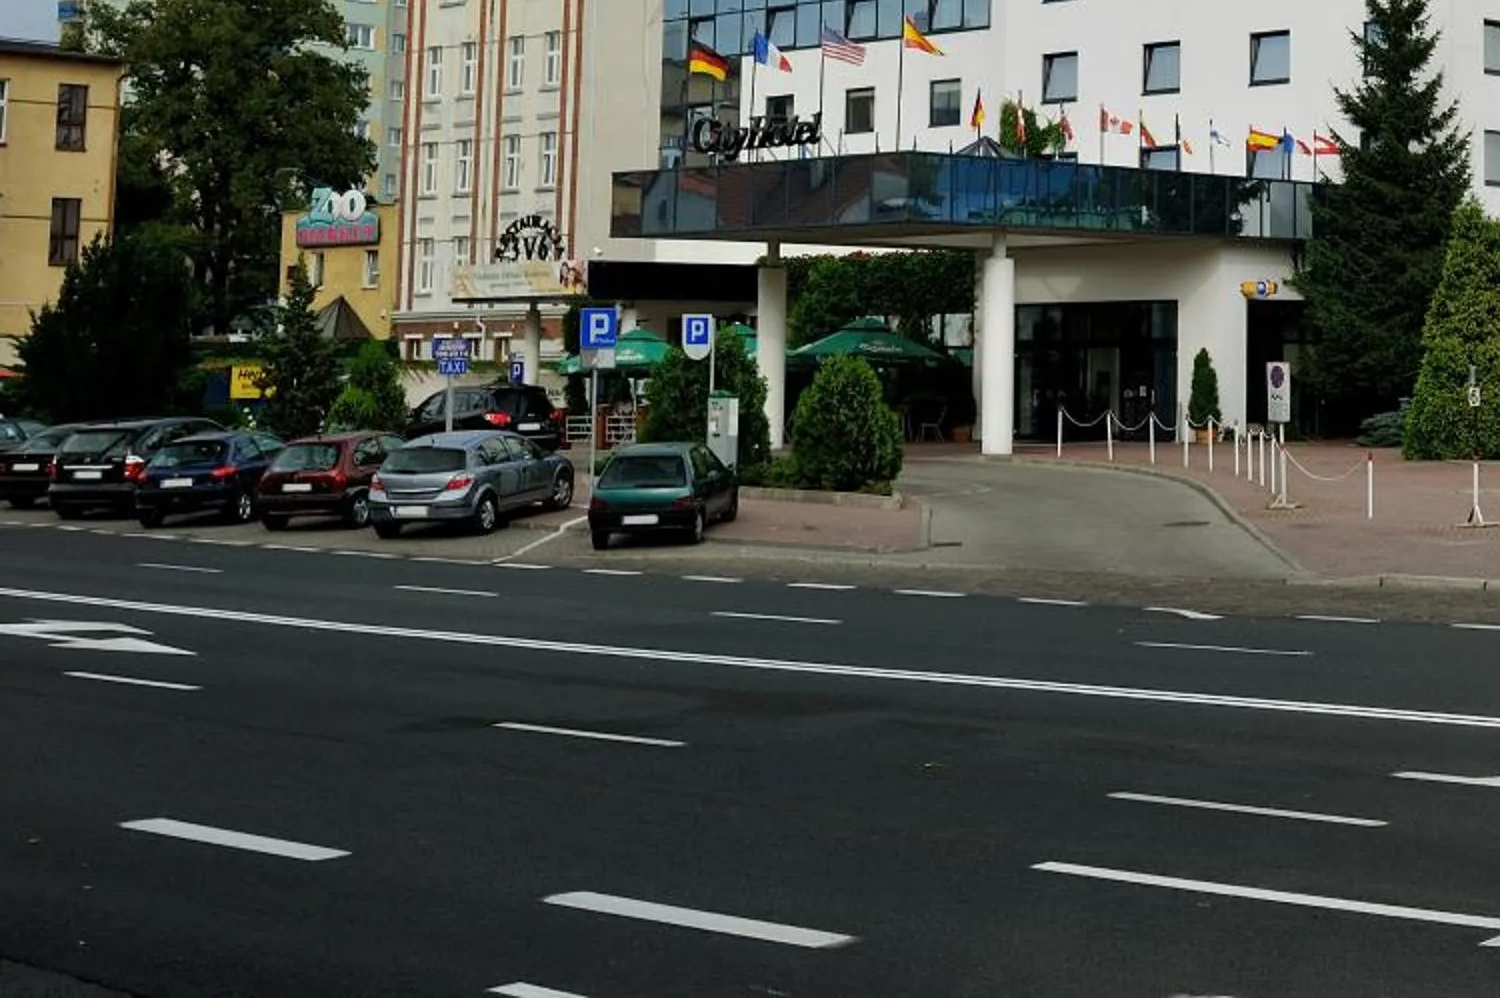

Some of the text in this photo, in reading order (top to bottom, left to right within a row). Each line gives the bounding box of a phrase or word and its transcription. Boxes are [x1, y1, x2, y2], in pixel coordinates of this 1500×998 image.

[310, 186, 367, 223] ZOO
[589, 313, 610, 344] P
[691, 319, 705, 343] P
[440, 361, 465, 374] TAXI
